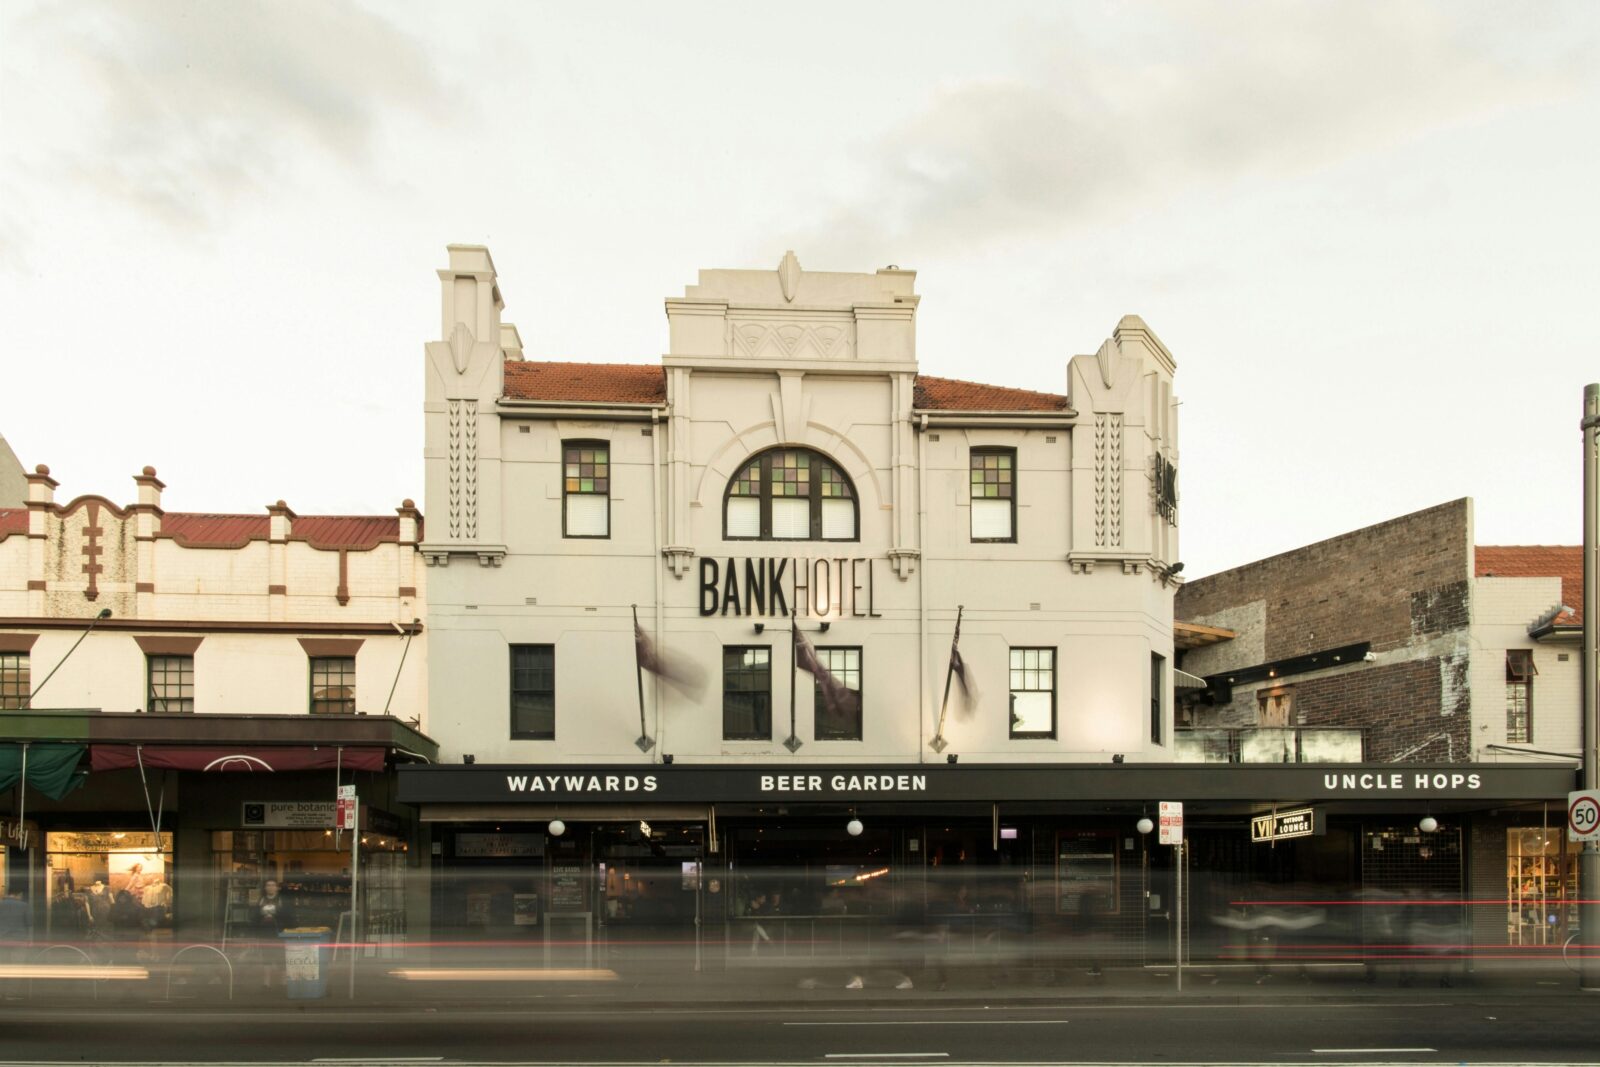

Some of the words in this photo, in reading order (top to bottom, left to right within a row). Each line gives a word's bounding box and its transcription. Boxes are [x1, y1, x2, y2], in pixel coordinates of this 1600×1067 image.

[699, 557, 788, 616] BANK
[793, 557, 882, 617] HOTEL
[506, 775, 658, 792] WAYWARDS
[760, 775, 823, 791] BEER
[830, 775, 926, 791] GARDEN
[1324, 773, 1403, 790] UNCLE
[1414, 773, 1481, 790] HOPS
[270, 804, 294, 813] pure
[297, 803, 337, 812] botanic
[1575, 807, 1596, 825] 50
[1280, 821, 1308, 834] LOUNGE
[1283, 815, 1304, 824] OUTDOOR
